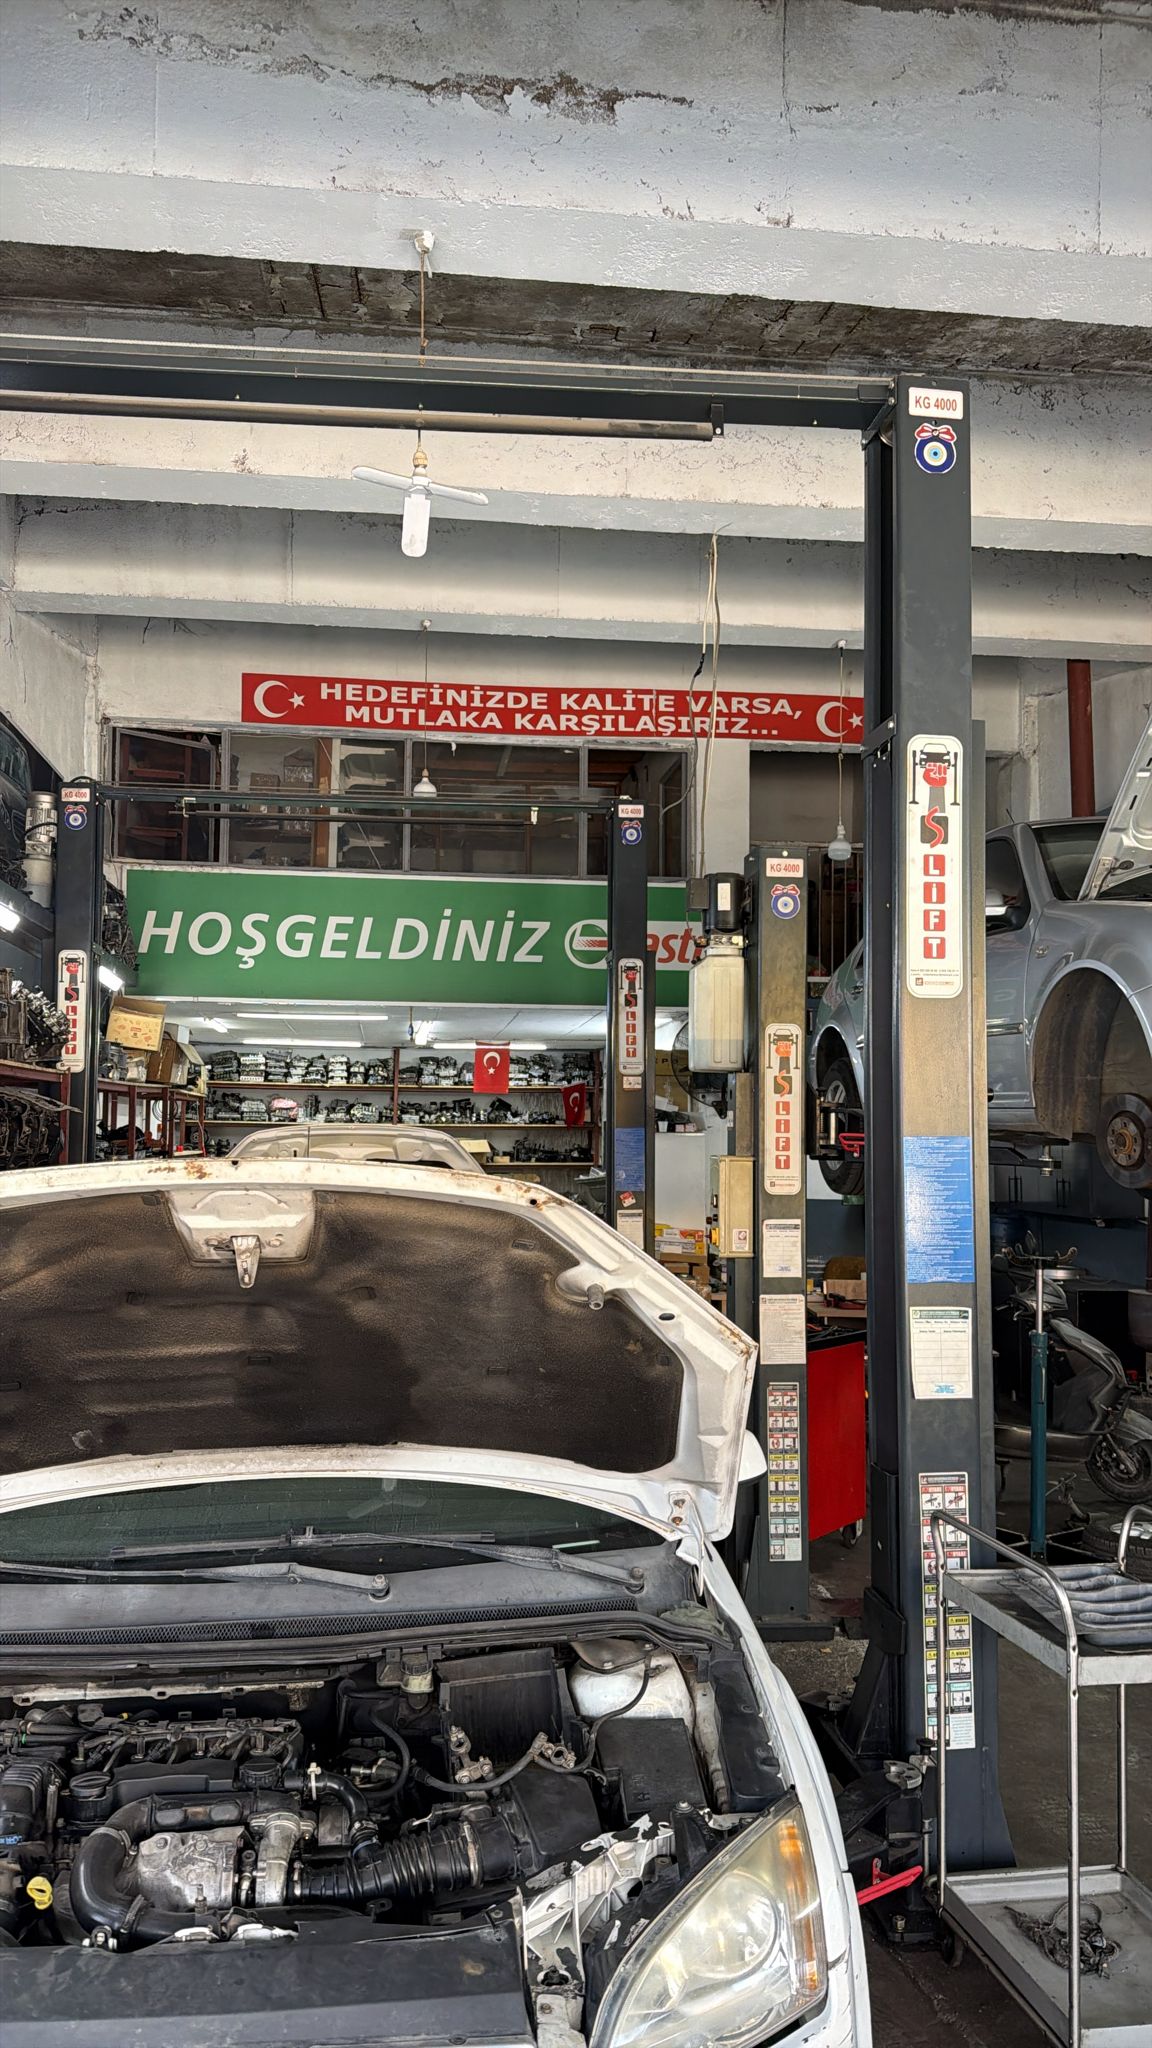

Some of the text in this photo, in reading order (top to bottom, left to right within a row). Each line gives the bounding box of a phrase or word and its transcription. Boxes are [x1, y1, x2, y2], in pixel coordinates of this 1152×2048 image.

[914, 395, 957, 411] KG 4000
[320, 682, 803, 720] HEDEFİNİZDE KALİTE VARSA,
[345, 705, 503, 729] MUTLAKA
[64, 791, 87, 799] KG 4000
[770, 863, 800, 873] KG 4000
[137, 908, 551, 969] HOŞGELDİNİZ
